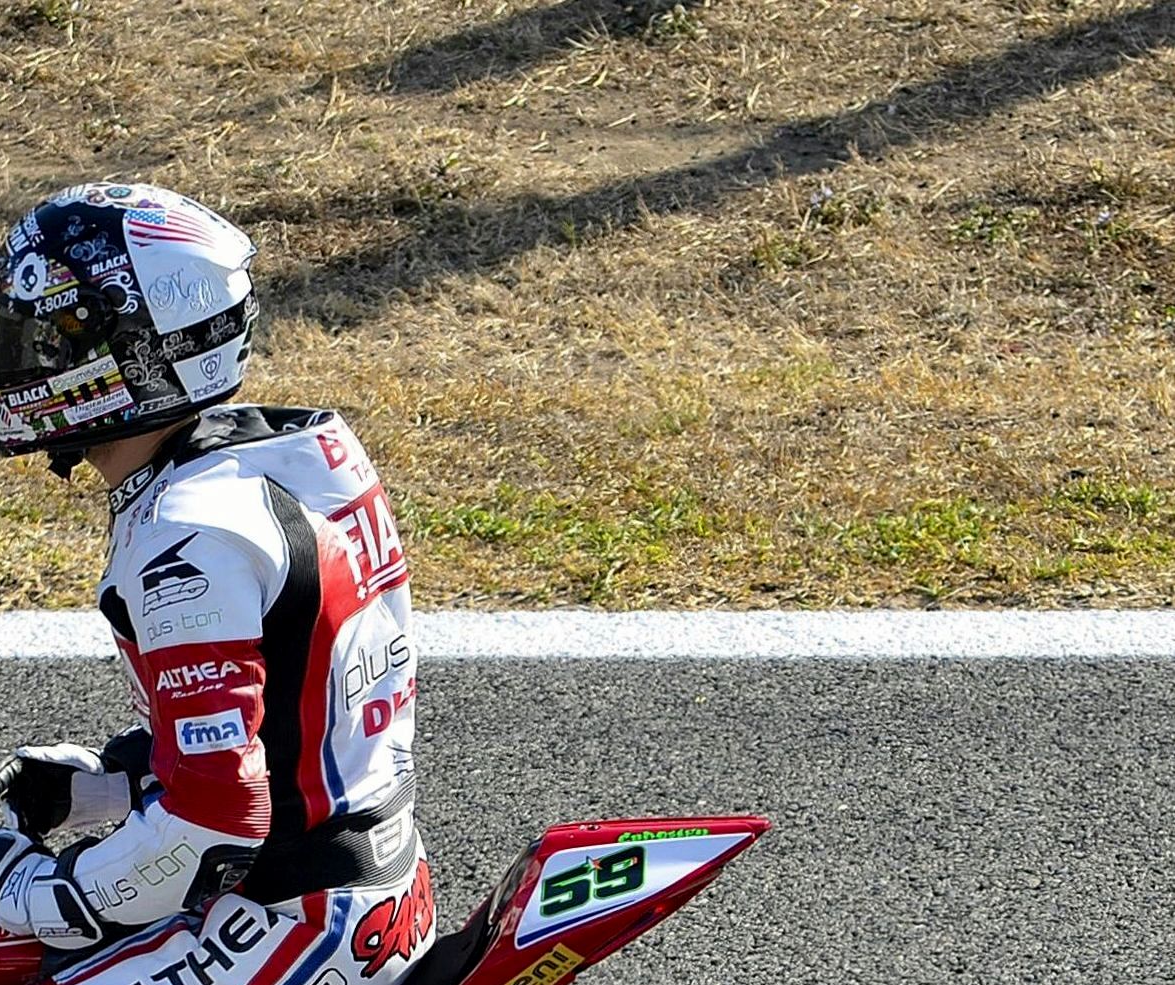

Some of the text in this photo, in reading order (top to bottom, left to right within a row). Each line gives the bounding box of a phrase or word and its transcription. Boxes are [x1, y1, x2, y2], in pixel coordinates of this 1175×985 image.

[91, 253, 129, 276] BLACK
[33, 288, 79, 317] X-802R
[8, 383, 50, 407] BLACK
[156, 660, 242, 691] ALTHEA
[182, 721, 241, 745] fma
[540, 846, 645, 918] 59
